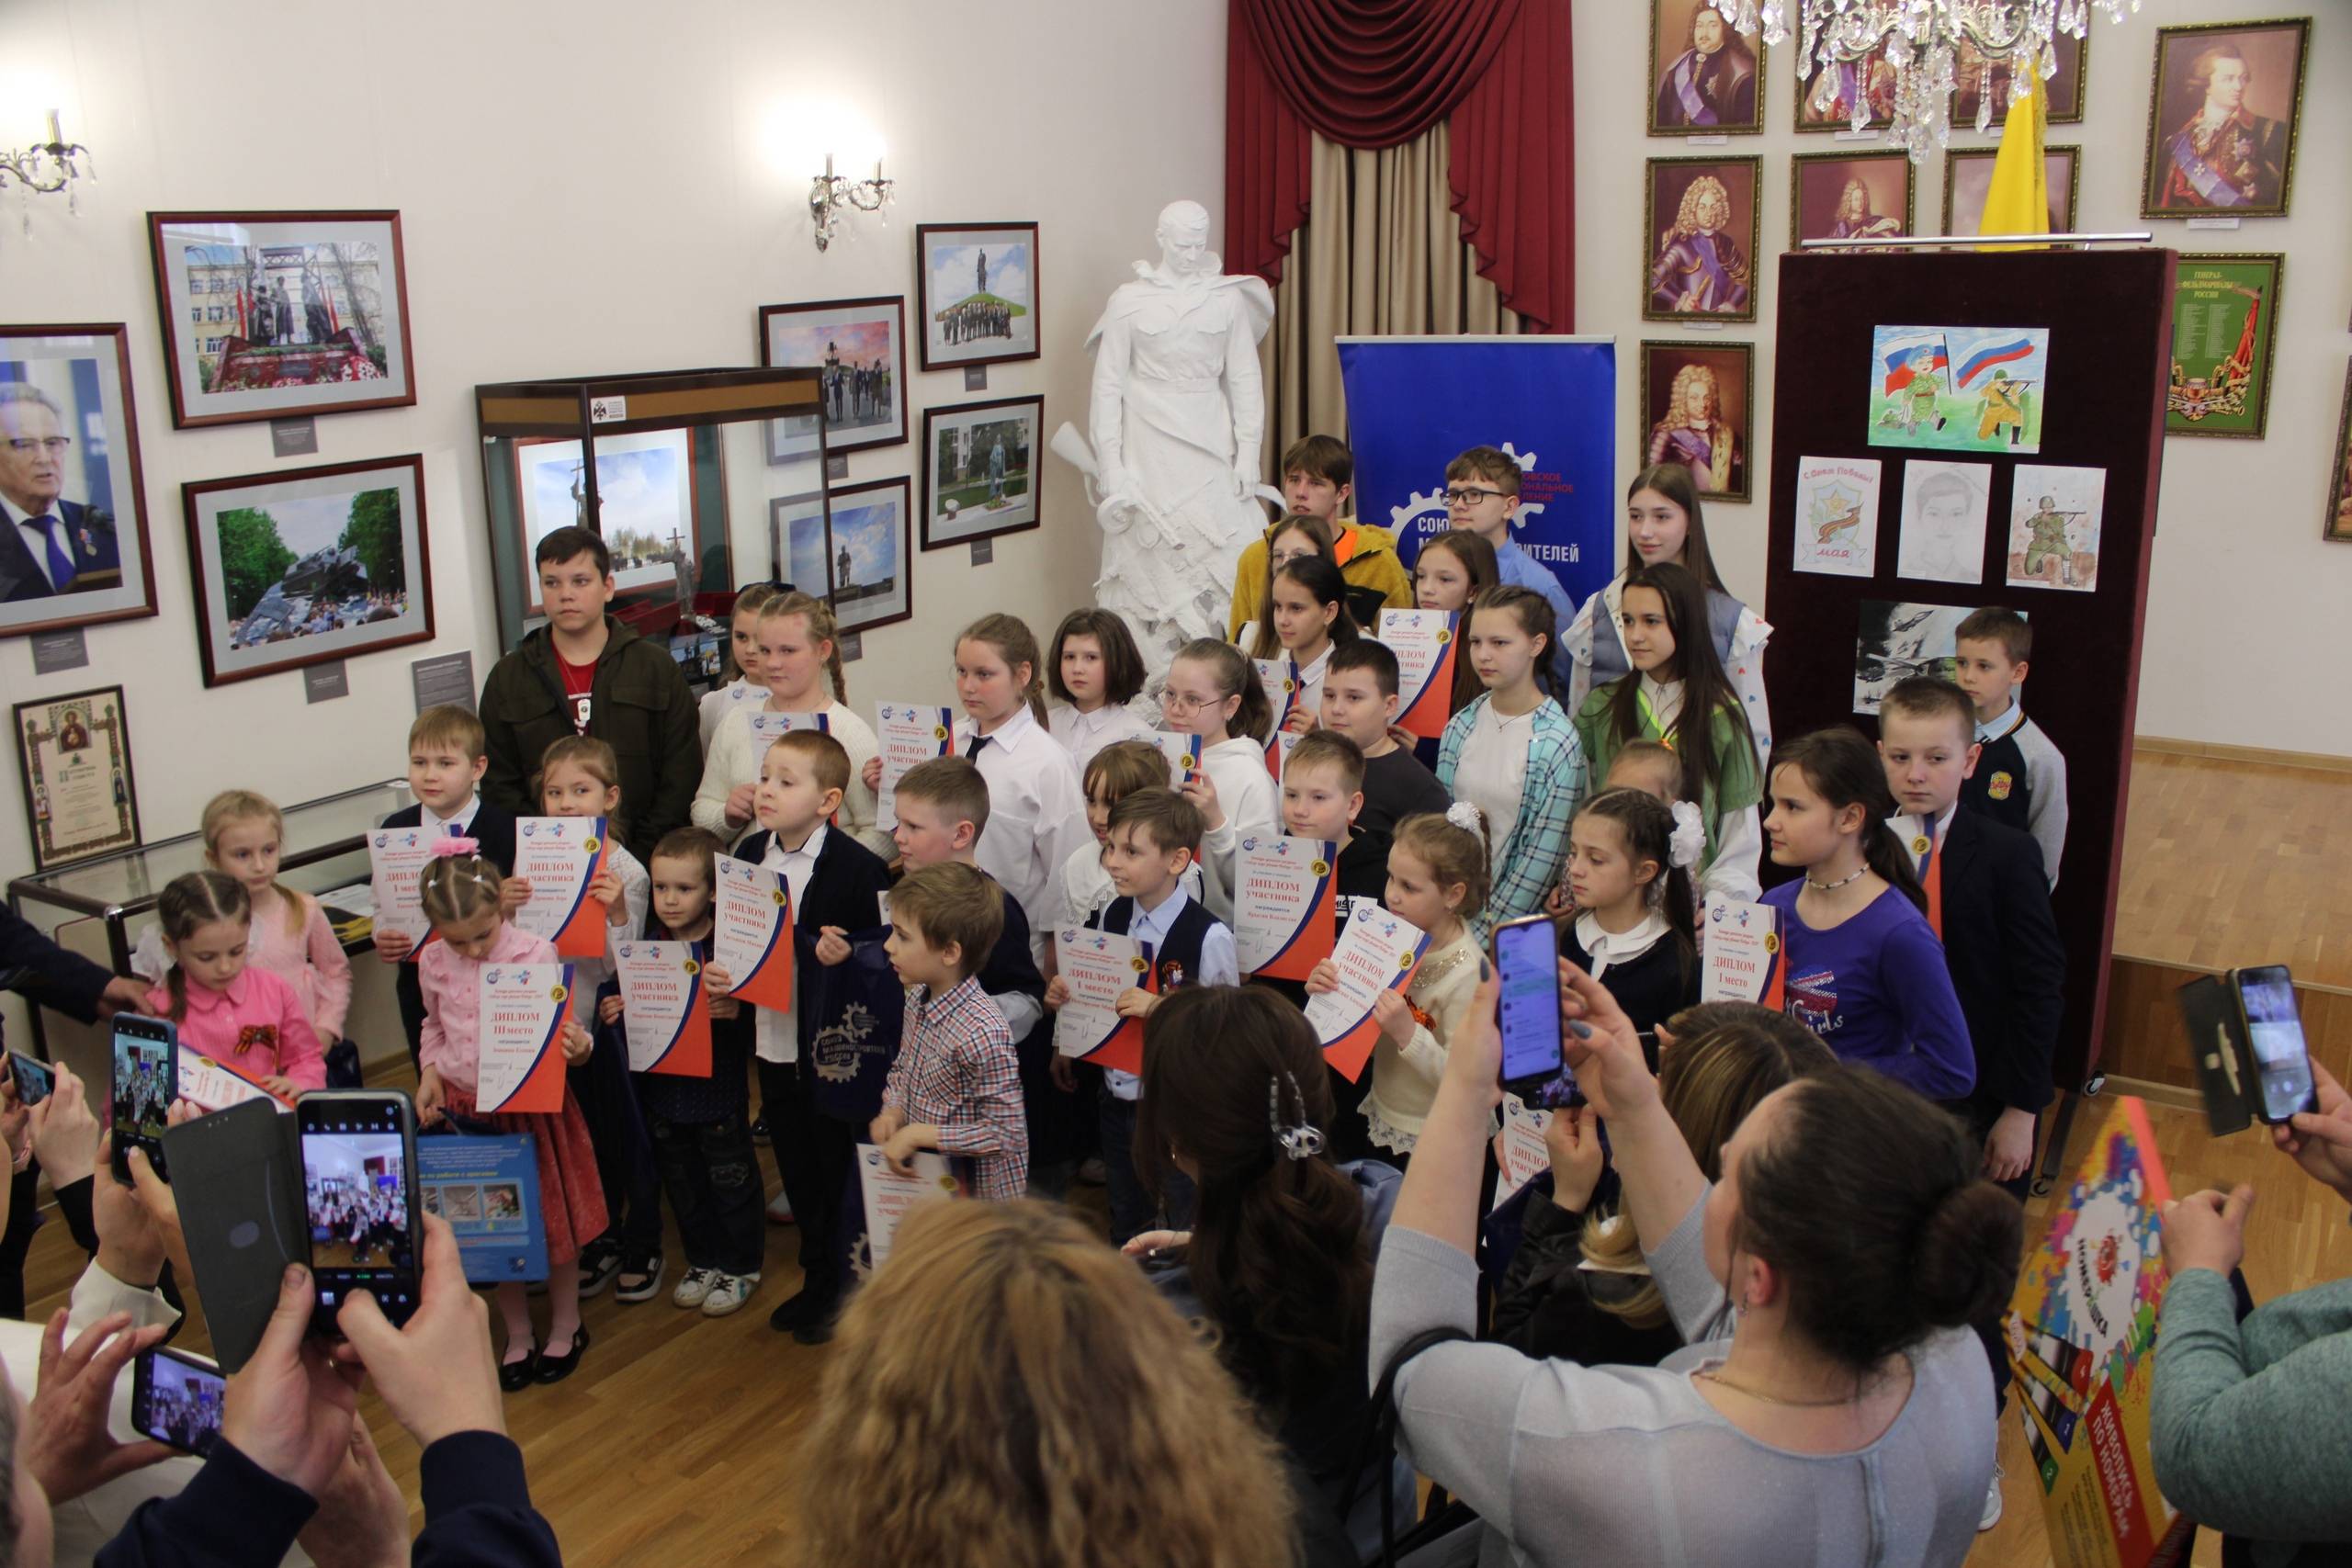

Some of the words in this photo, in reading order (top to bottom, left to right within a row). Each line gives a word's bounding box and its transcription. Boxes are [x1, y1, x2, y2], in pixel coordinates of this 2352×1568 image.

[1521, 472, 1562, 482] ОВСКОЕ
[1521, 482, 1574, 493] ОНАЛЬНОЕ
[1418, 517, 1450, 533] СОЮ
[887, 743, 927, 756] ДИПЛОМ
[526, 862, 574, 873] ДИПЛОМ
[386, 872, 419, 883] ДИПЛ
[1246, 876, 1301, 893] ДИПЛОМ
[401, 885, 418, 893] мес
[1246, 888, 1301, 904] участника
[725, 899, 766, 919] ДИПЛОМ
[723, 912, 767, 931] участника
[1343, 948, 1386, 980] ДИПЛОМ
[1712, 954, 1756, 974] ДИПЛОМ
[1068, 965, 1122, 987] ДИПЛОМ
[1339, 962, 1379, 992] участника
[1724, 976, 1748, 987] место
[630, 980, 678, 992] ДИПЛОМ
[1083, 985, 1114, 996] место
[630, 992, 680, 1002] участника
[490, 1011, 540, 1023] ДИПЛОМ
[493, 1025, 505, 1035] III
[506, 1027, 534, 1036] место
[2092, 1415, 2106, 1446] ПО
[2100, 1399, 2133, 1509] ЖИВОПИСЬ
[2098, 1444, 2130, 1540] НОМЕРАМ
